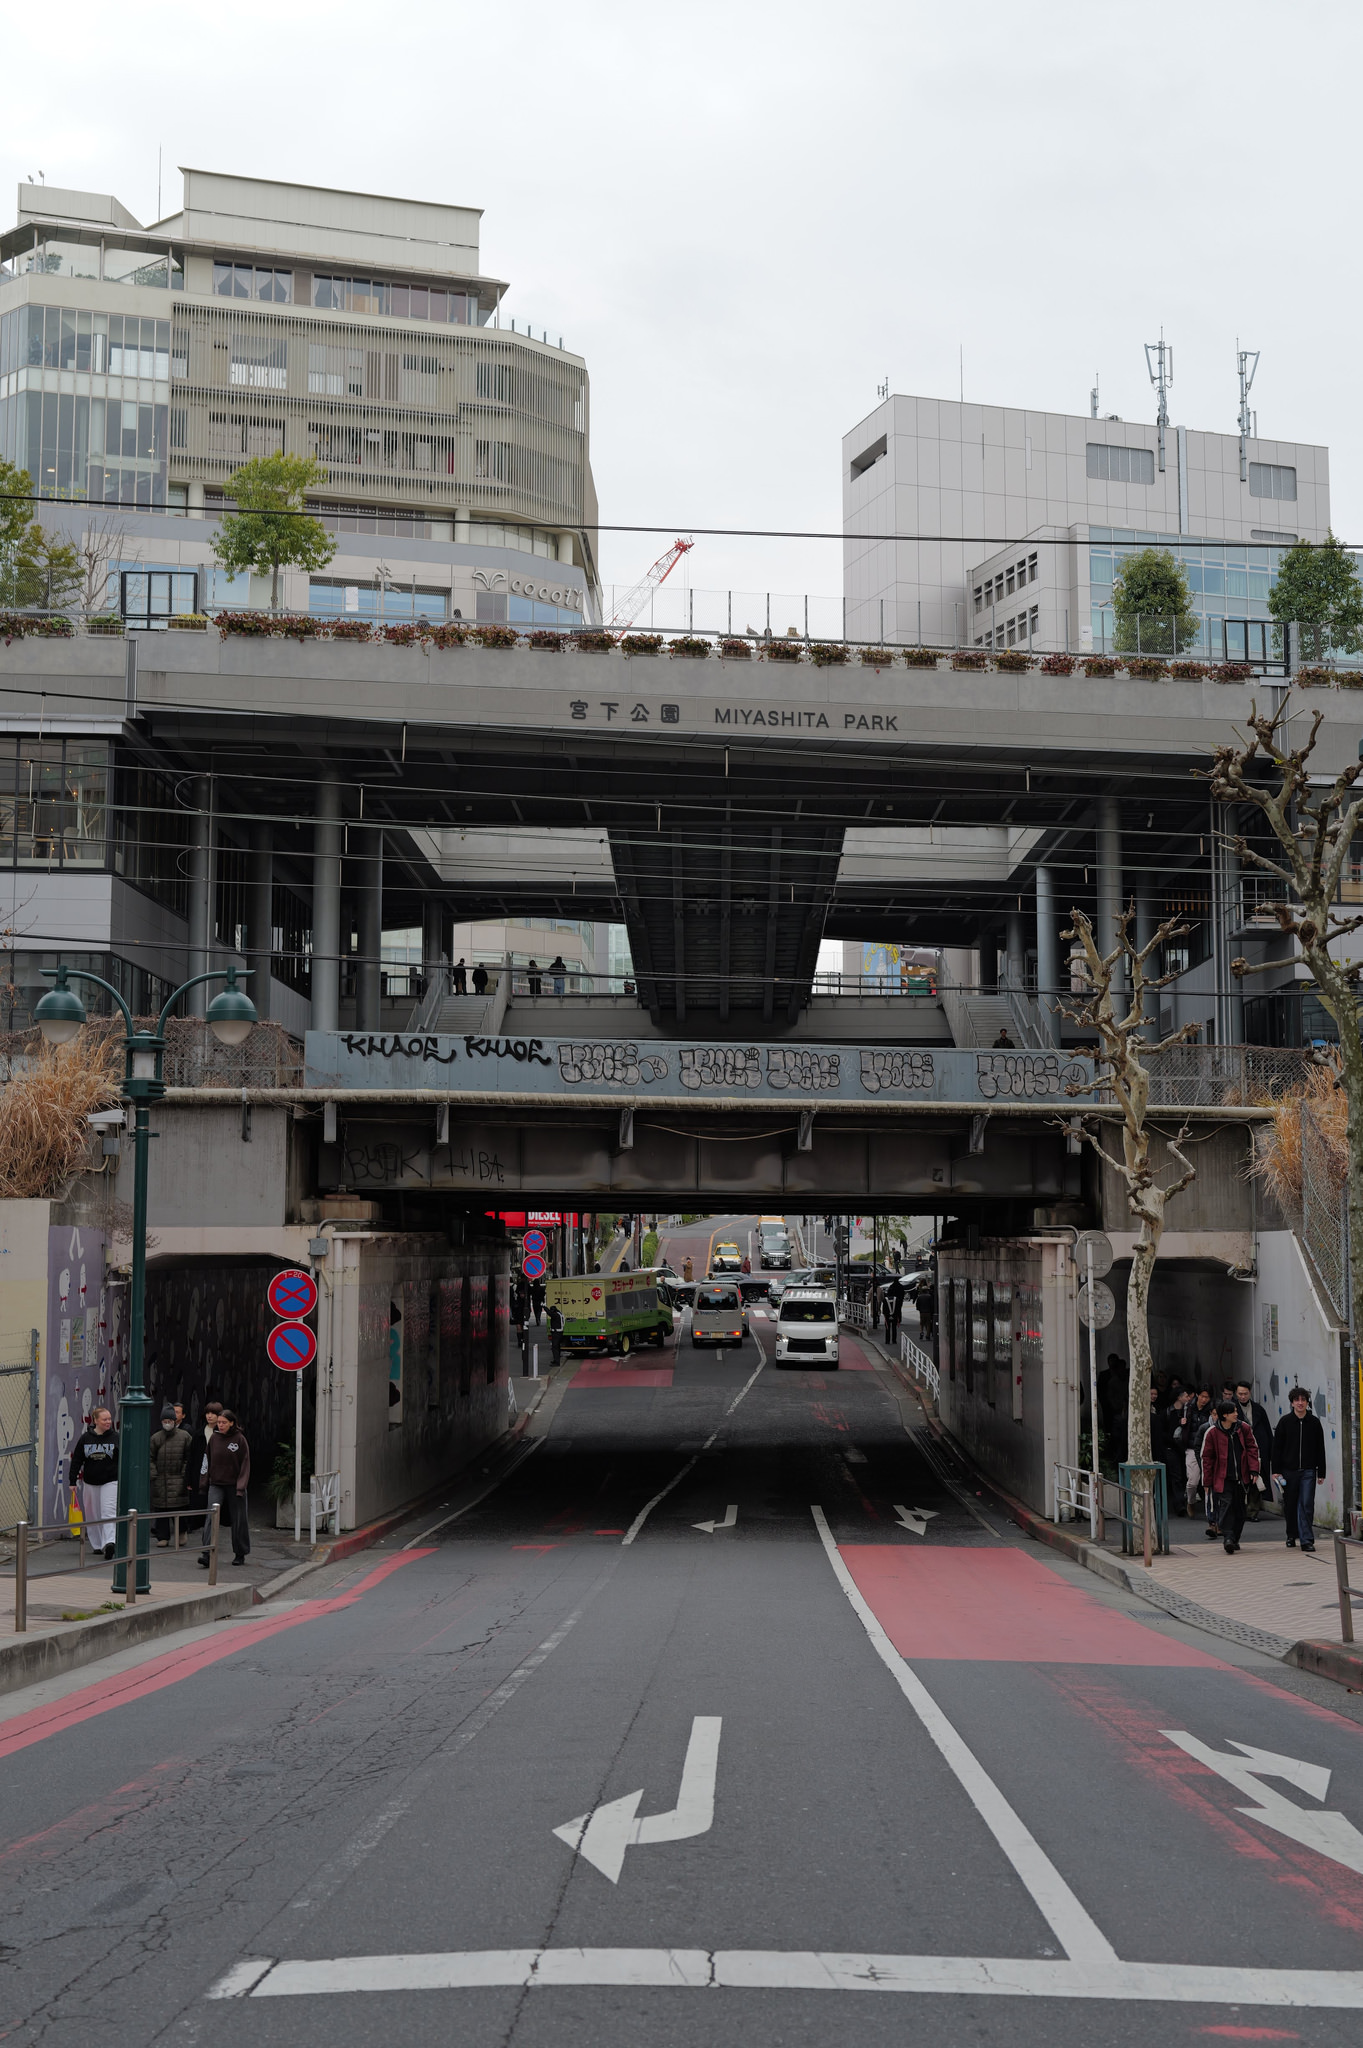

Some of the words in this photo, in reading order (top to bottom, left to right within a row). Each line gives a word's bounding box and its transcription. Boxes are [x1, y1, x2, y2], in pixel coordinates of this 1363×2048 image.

[569, 699, 680, 724] 宮下公園
[714, 707, 830, 729] MIYASHITA
[843, 713, 899, 732] PARK
[282, 1271, 303, 1279] 7-20
